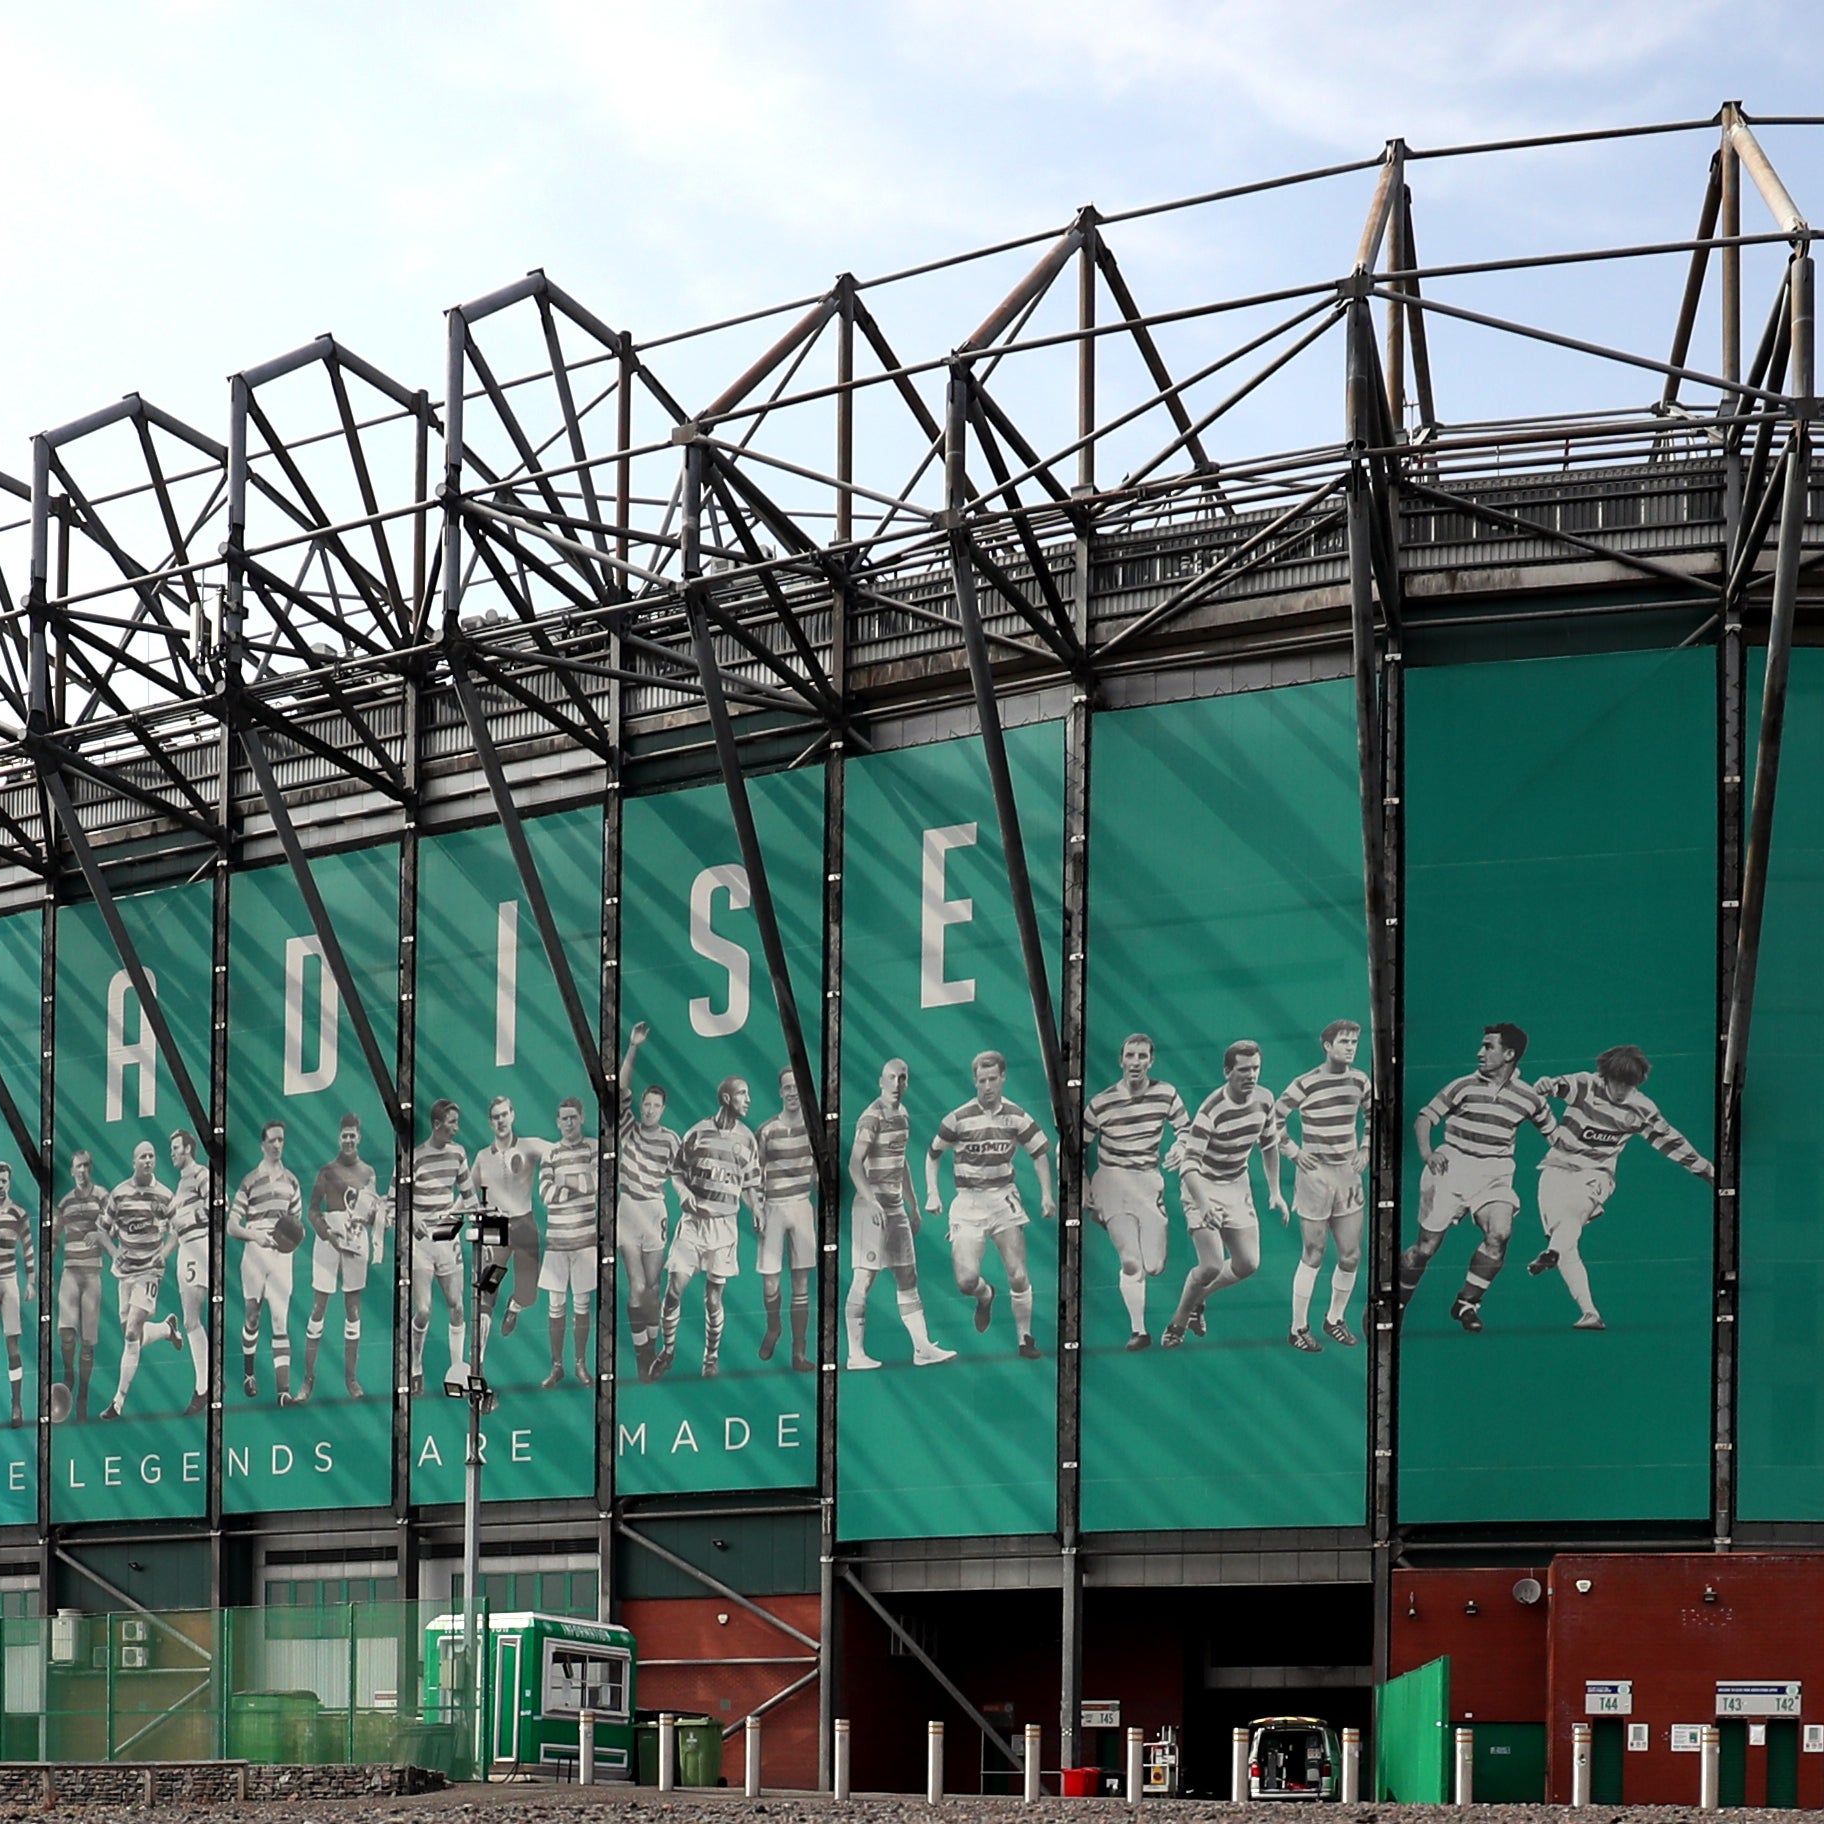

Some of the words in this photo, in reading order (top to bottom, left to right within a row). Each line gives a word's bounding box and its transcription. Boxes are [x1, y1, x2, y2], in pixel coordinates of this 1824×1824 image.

[184, 1260, 197, 1283] 5
[144, 1280, 158, 1299] 10
[70, 1440, 334, 1489] LEGENDS
[419, 1428, 533, 1467] ARE
[619, 1412, 802, 1457] MADE
[1599, 1697, 1619, 1711] T44
[1722, 1697, 1742, 1712] T43
[1775, 1697, 1795, 1712] T42
[1100, 1713, 1114, 1725] T45
